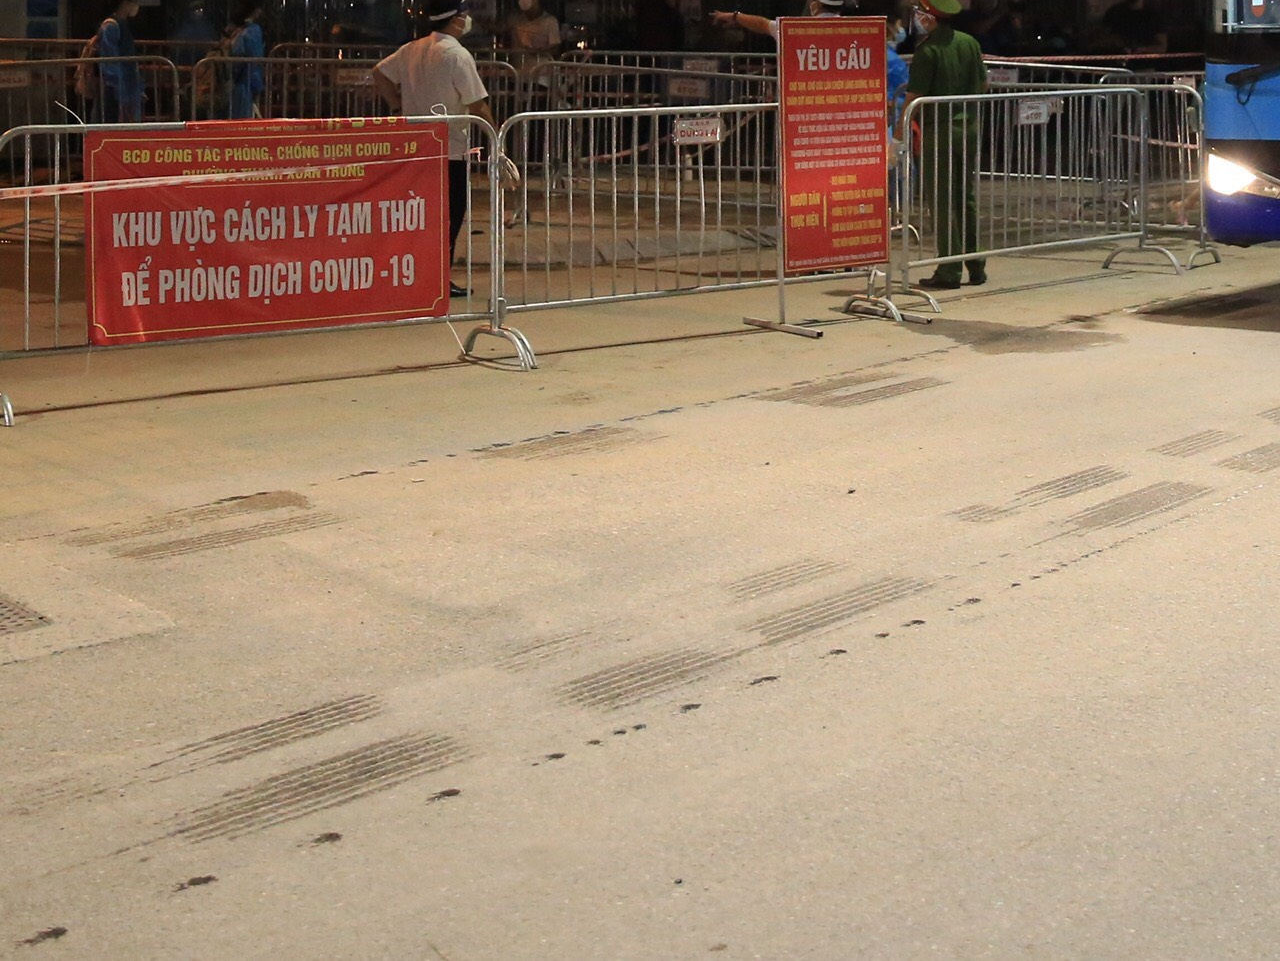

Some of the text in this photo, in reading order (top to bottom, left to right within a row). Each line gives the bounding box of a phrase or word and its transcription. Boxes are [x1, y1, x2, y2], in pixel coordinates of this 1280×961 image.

[796, 40, 871, 71] YÊU CẦU
[122, 149, 150, 163] BCĐ
[155, 146, 192, 163] CÔNG
[195, 145, 221, 161] TÁC
[225, 143, 273, 161] PHÒNG,
[277, 140, 319, 159] CHỐNG
[323, 143, 352, 161] DỊCH
[356, 142, 390, 156] COVID
[403, 141, 417, 154] 19
[325, 165, 365, 178] TRUNG
[112, 190, 426, 251] KHU VỰC CÁCH LY TẠM THỜI
[121, 256, 152, 307] ĐỂ
[158, 264, 241, 303] PHÒNG
[248, 262, 302, 304] DỊCH
[309, 258, 374, 293] COVID
